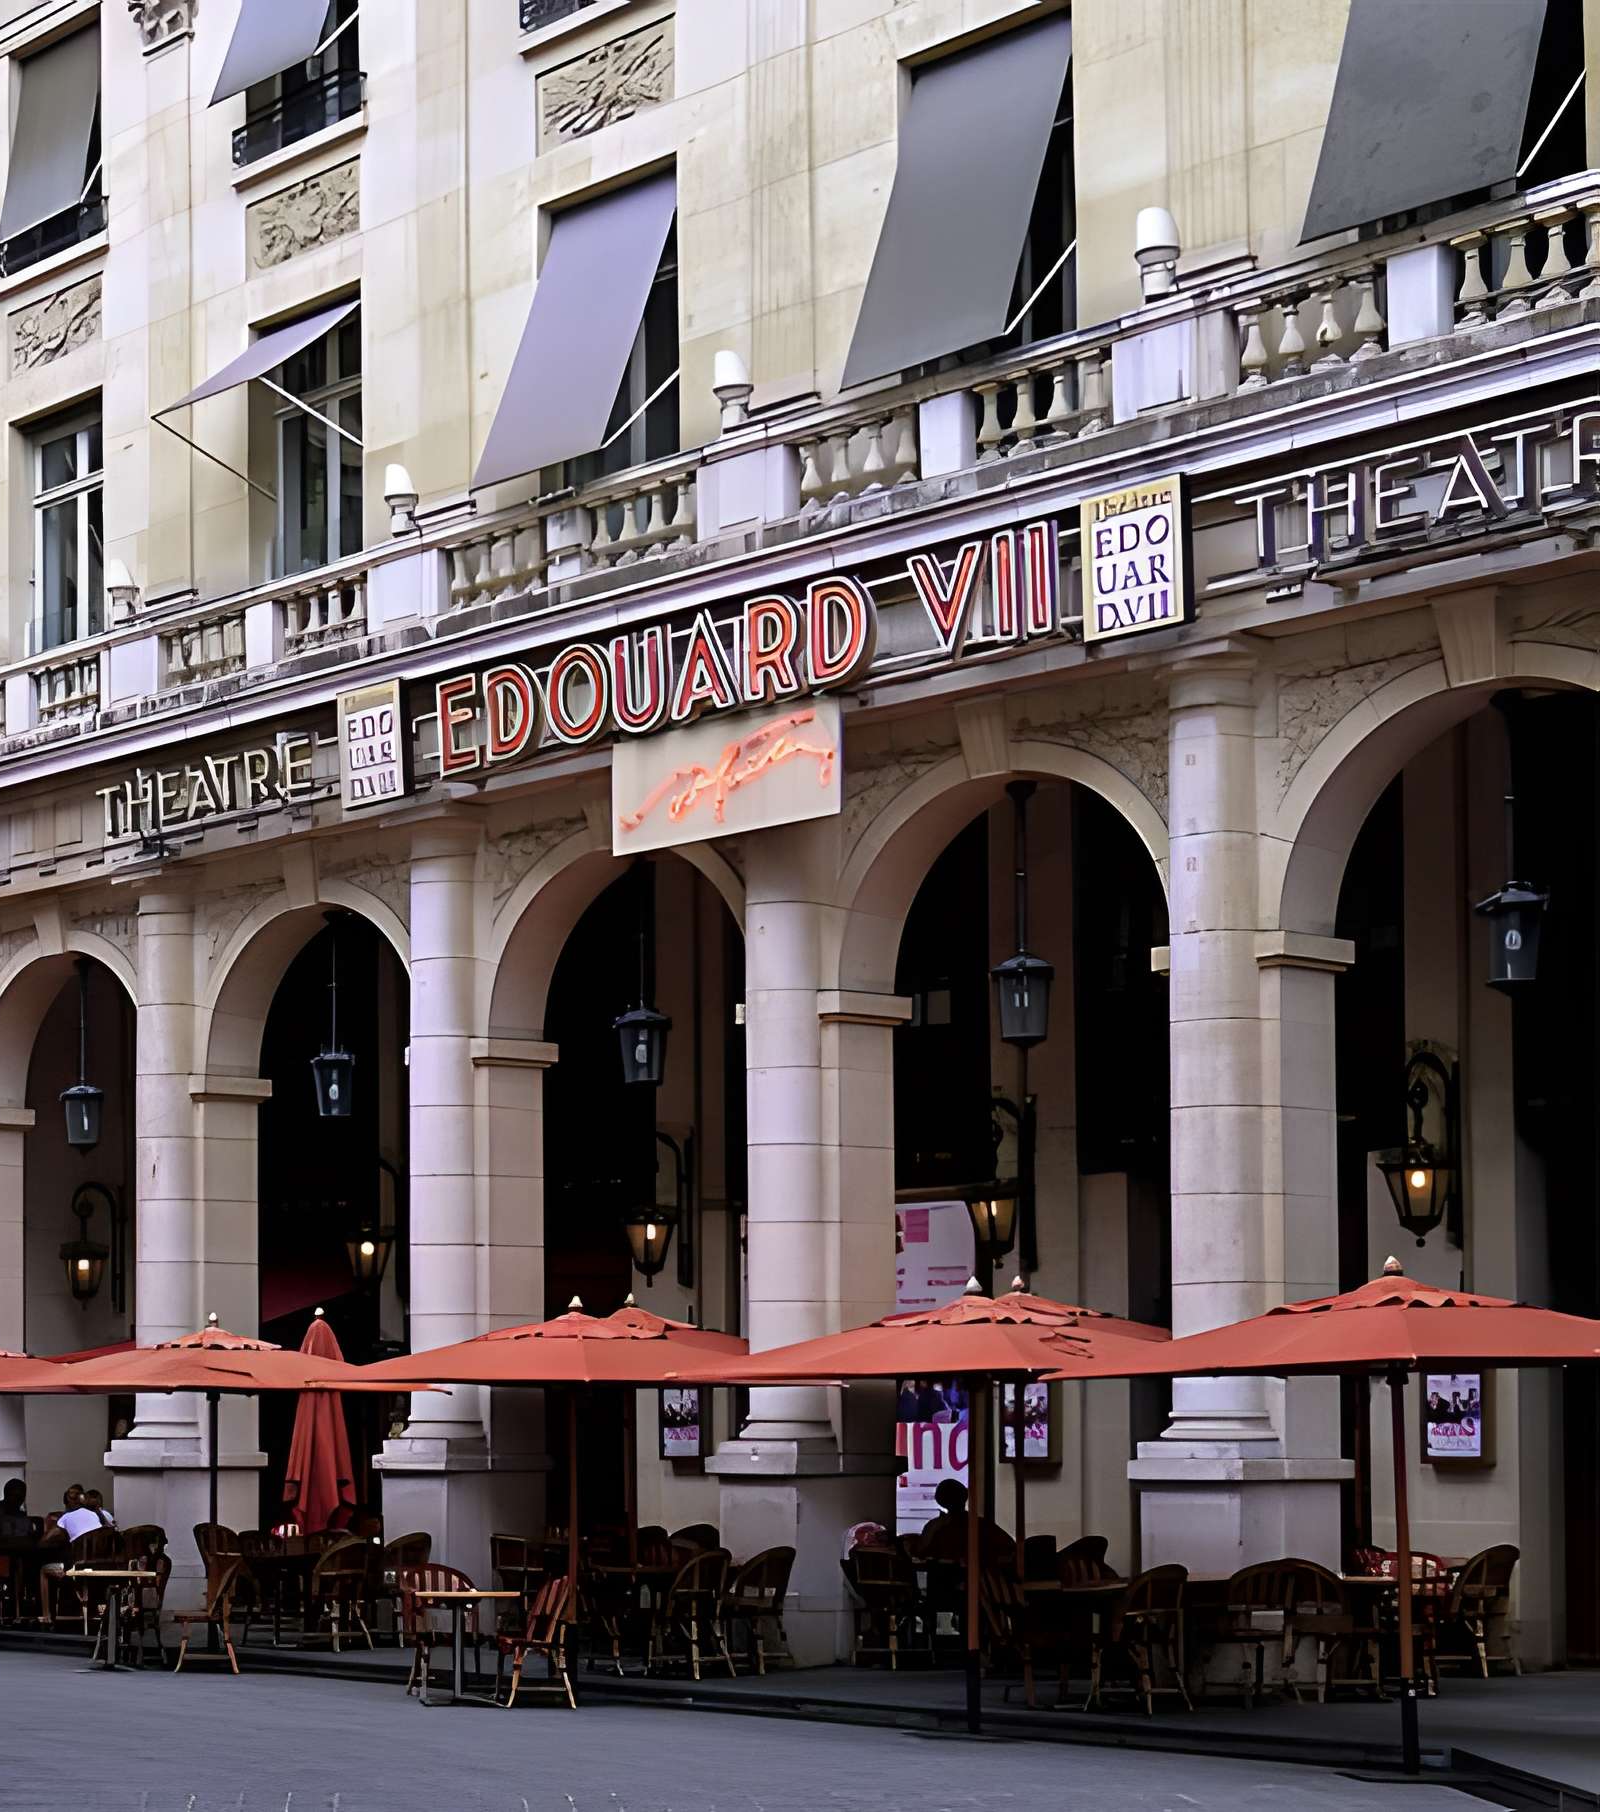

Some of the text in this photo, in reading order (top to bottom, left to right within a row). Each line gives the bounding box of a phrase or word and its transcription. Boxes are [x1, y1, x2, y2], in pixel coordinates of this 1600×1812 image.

[1095, 514, 1170, 559] EDO
[1096, 553, 1170, 595] UAR
[436, 575, 872, 779] EDOUARD
[95, 732, 314, 838] THEATRE
